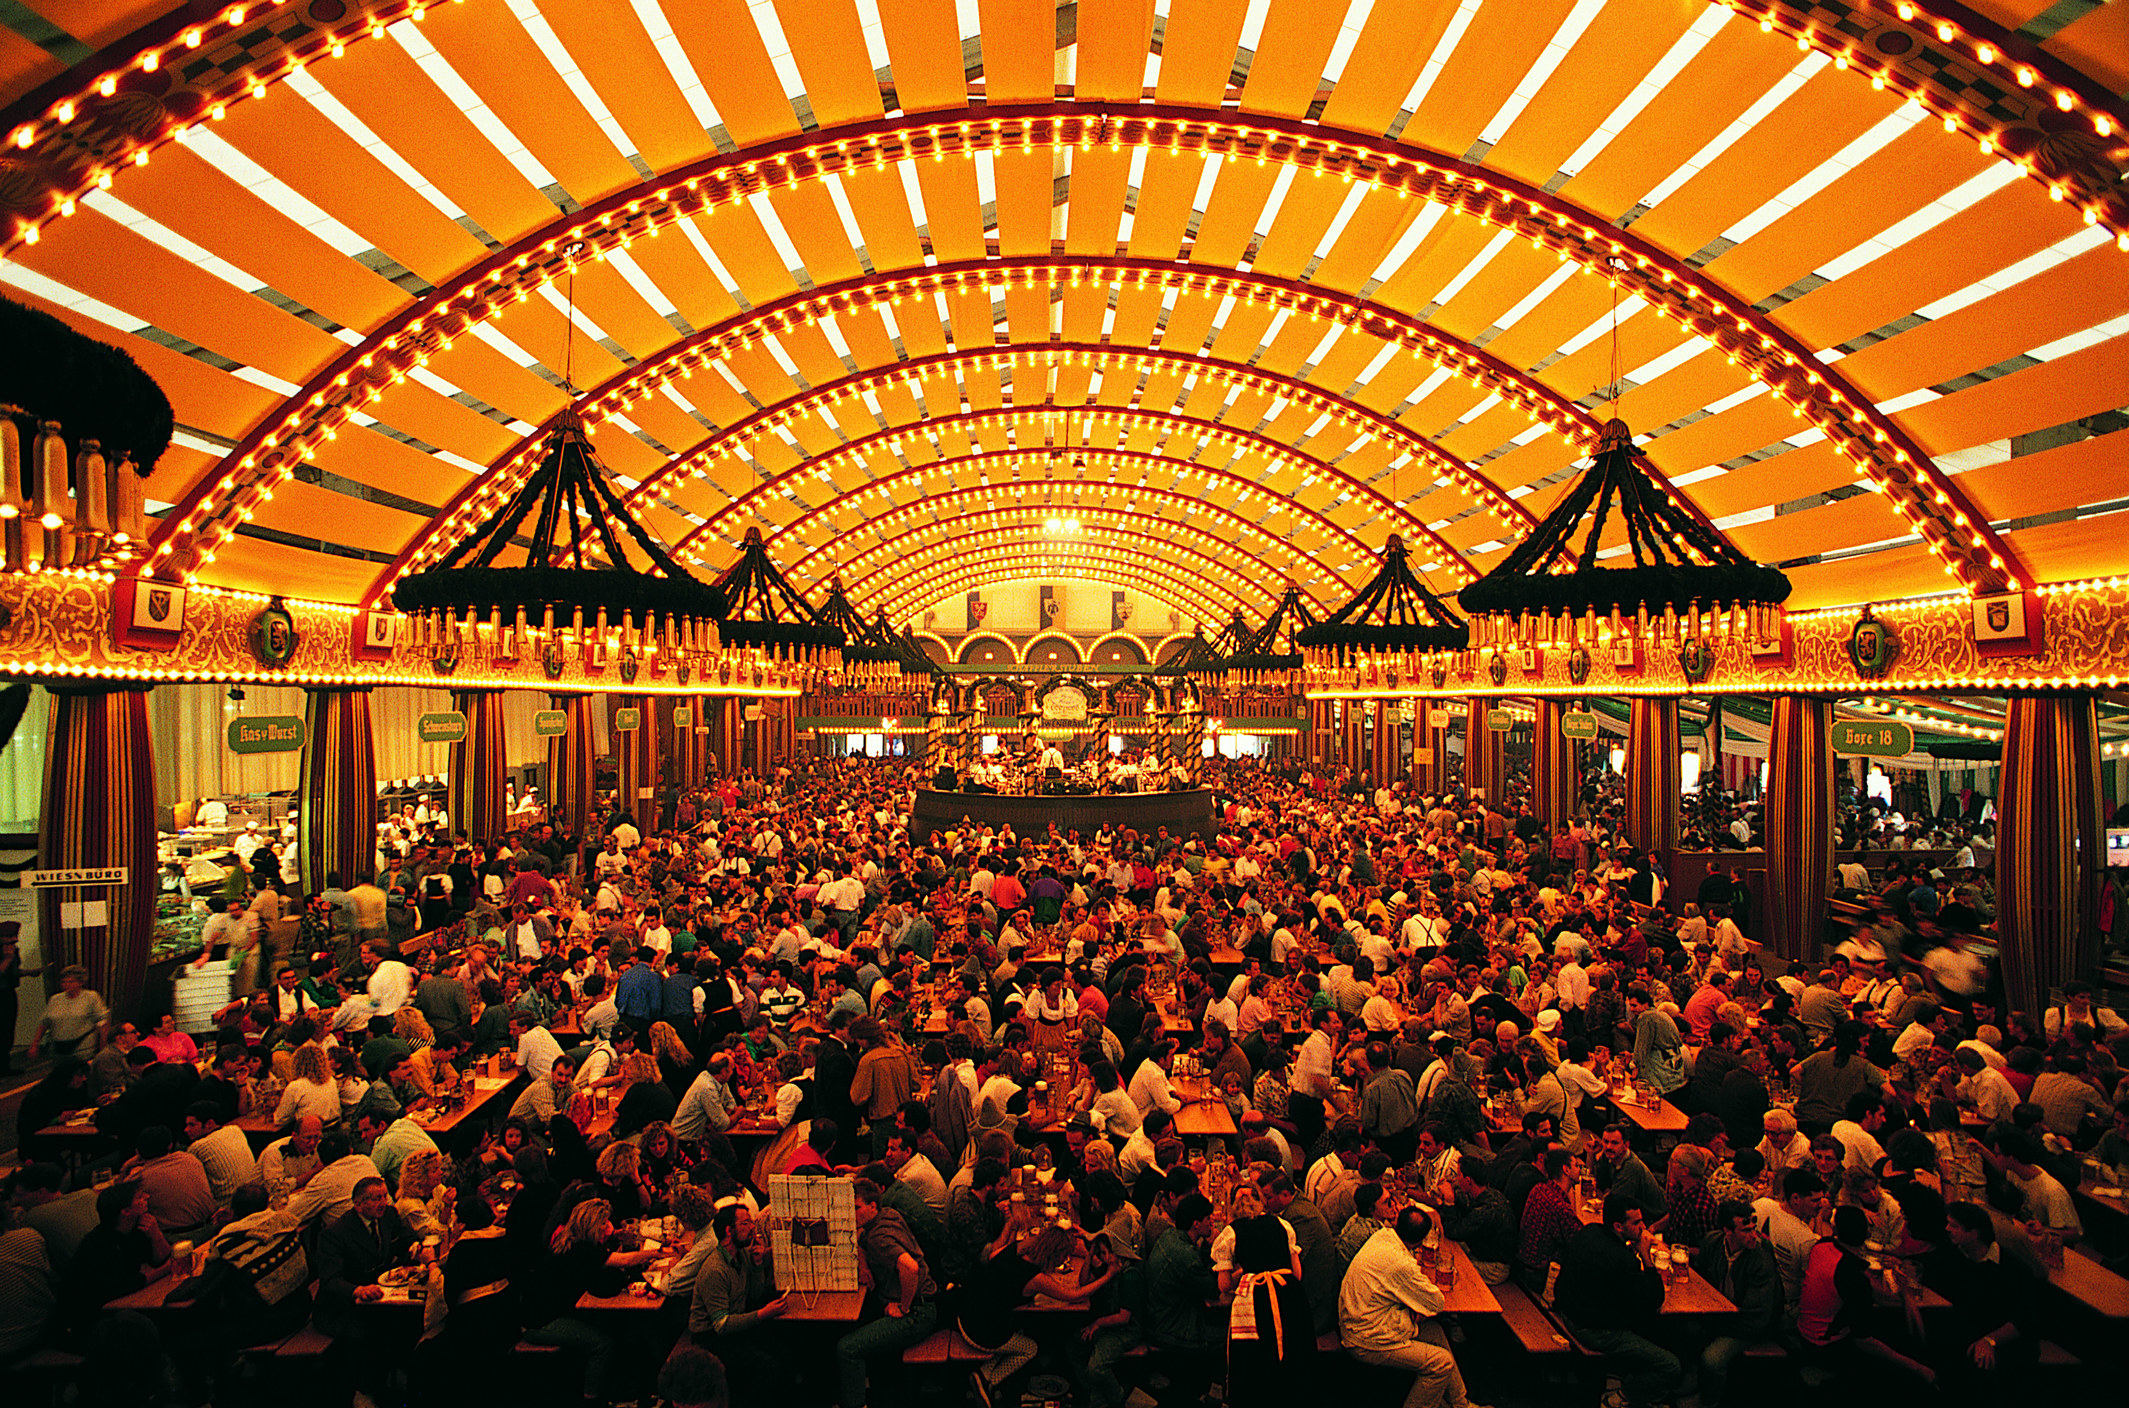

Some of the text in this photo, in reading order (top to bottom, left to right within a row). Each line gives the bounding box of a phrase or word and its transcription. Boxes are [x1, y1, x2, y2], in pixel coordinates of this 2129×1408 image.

[268, 724, 297, 740] Wurst
[1846, 728, 1893, 745] Boxe 18
